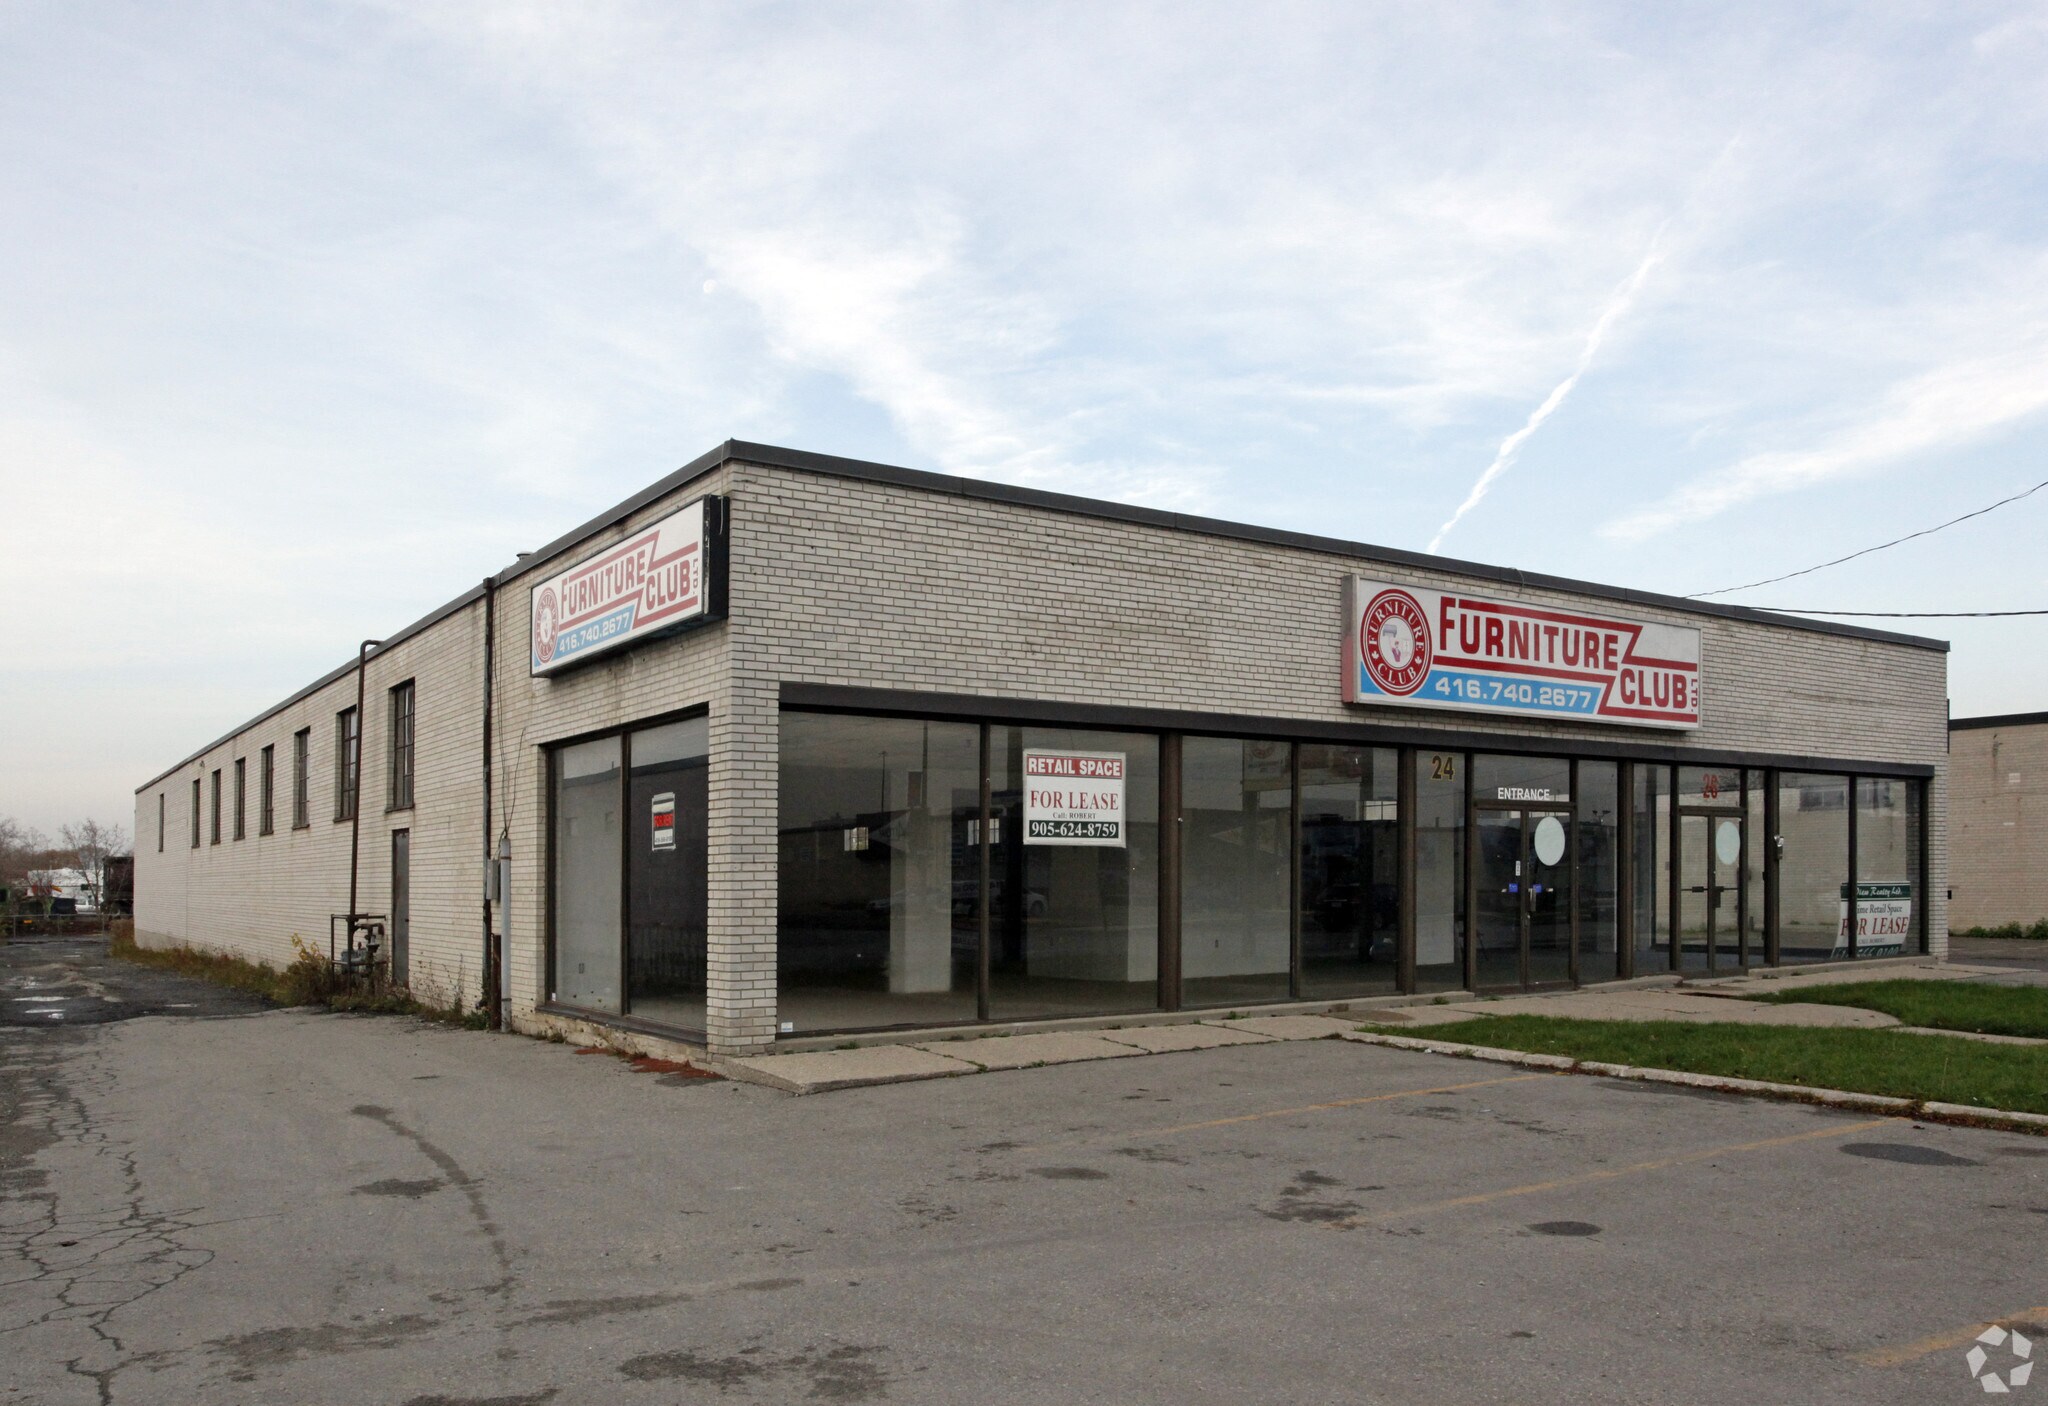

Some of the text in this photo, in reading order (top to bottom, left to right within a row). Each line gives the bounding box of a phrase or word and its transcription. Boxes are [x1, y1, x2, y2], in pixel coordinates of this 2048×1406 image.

[561, 549, 645, 619] FURNITURE
[646, 559, 690, 611] CLUB
[559, 612, 630, 653] 416.740.2677
[1368, 601, 1424, 651] FURNITURE
[1440, 596, 1618, 671] FURNITURE
[1377, 663, 1417, 685] CLUB
[1435, 676, 1592, 708] 416.740.2677
[1620, 668, 1698, 712] CLUB LTD.
[1028, 758, 1120, 776] RETAIL SPACE
[1432, 755, 1455, 780] 24
[1030, 790, 1119, 810] FOR LEASE
[1497, 787, 1550, 800] ENTRANCE
[1031, 822, 1117, 837] 905-624-8759
[1869, 904, 1887, 914] Retail
[1887, 904, 1903, 916] Space
[1840, 917, 1909, 937] FR LEASE
